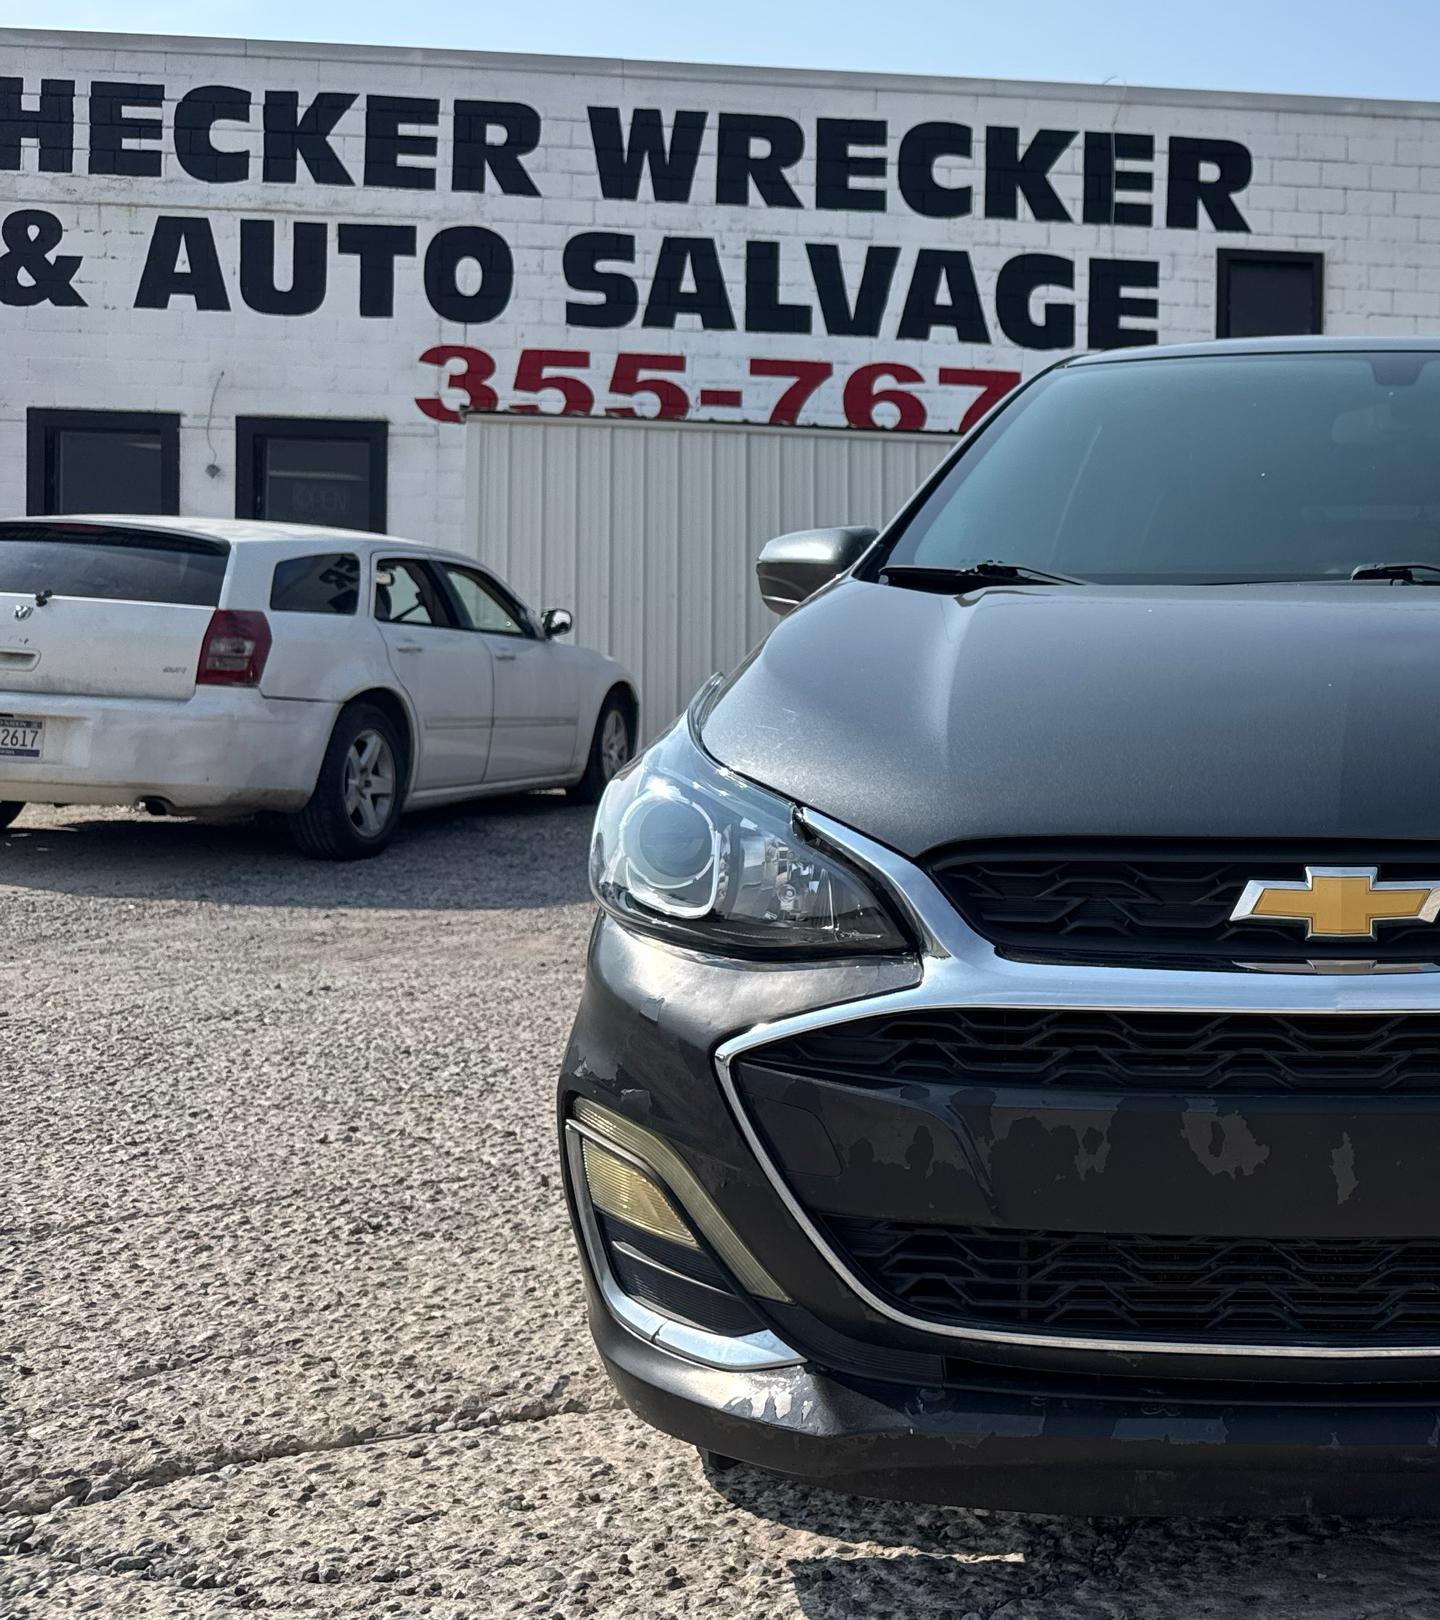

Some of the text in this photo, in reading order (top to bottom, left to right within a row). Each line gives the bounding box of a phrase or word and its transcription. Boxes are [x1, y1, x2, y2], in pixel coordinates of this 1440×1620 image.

[0, 77, 1253, 234] HECKER WRECKER
[0, 208, 1160, 350] & AUTO SALVAGE
[1, 728, 39, 748] 2617
